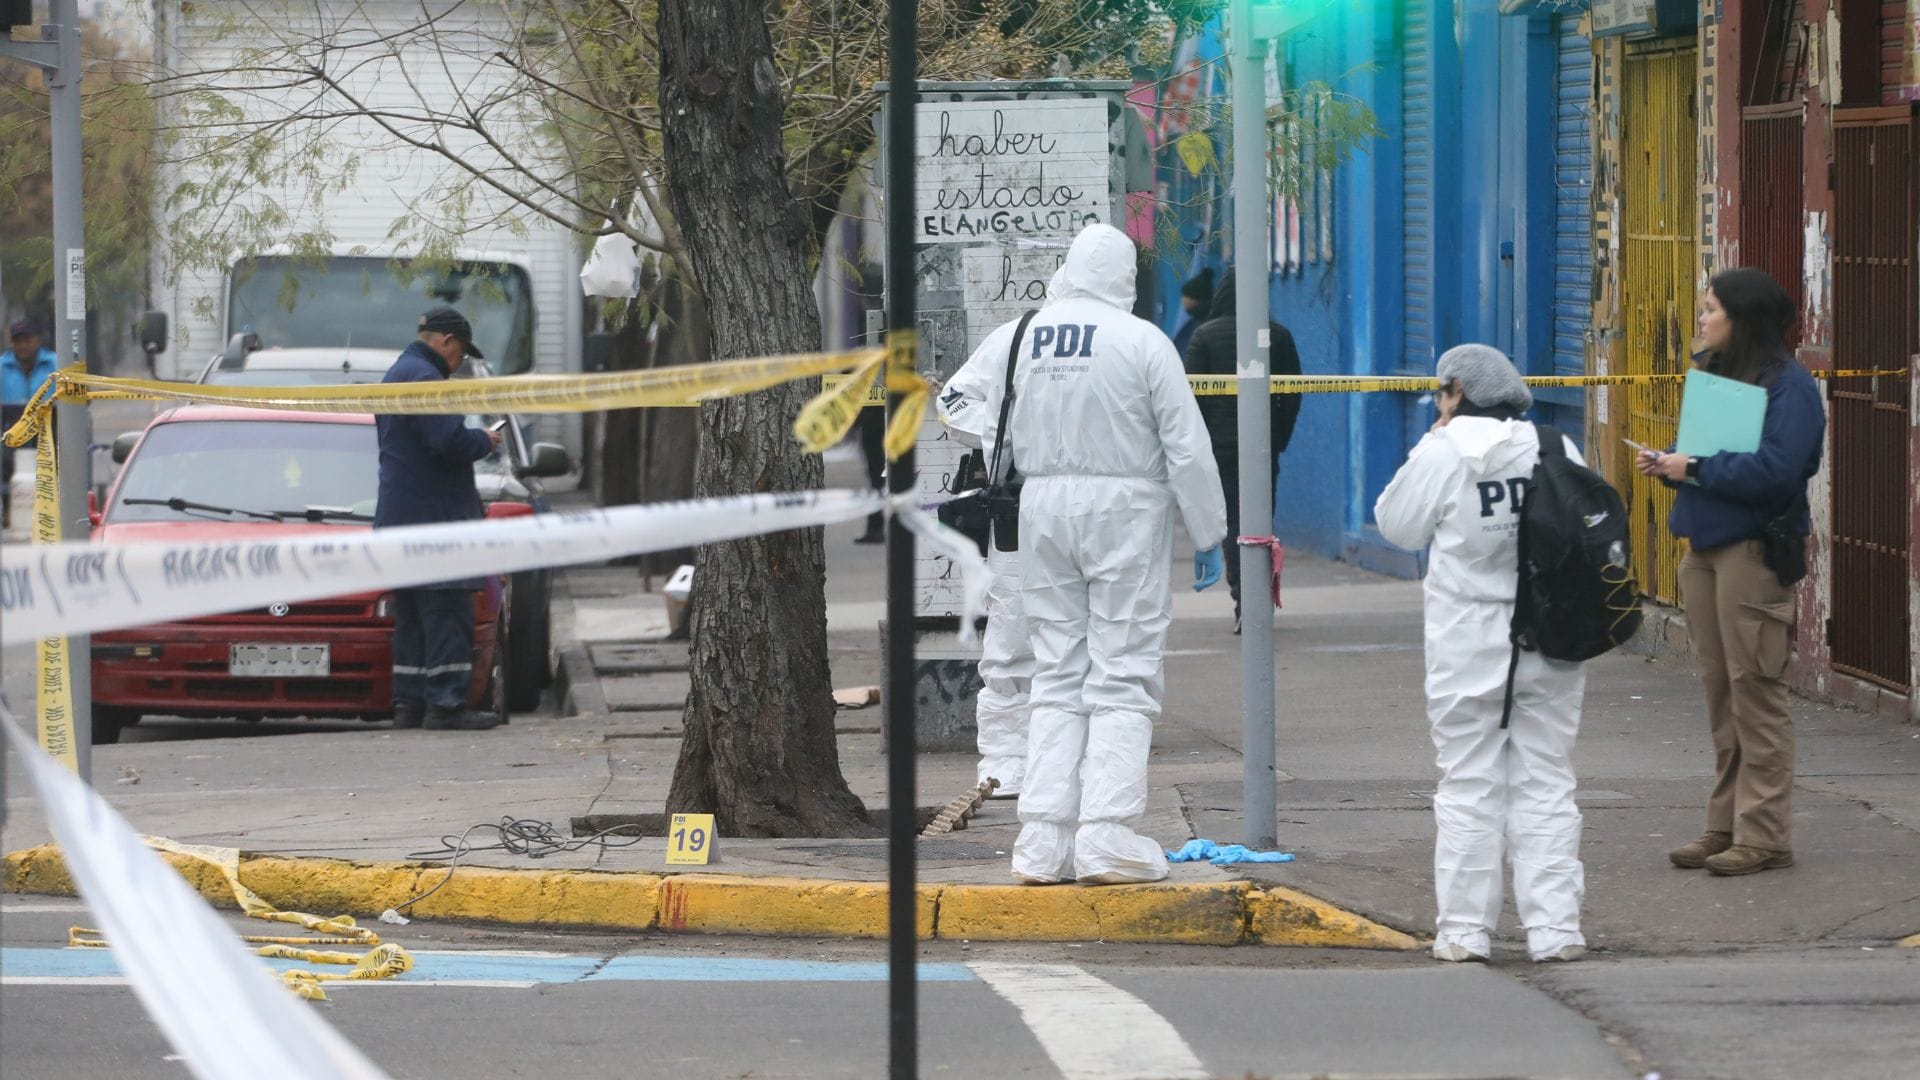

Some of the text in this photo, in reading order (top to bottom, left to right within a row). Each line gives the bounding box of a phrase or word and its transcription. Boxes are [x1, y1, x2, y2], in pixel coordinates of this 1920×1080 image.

[932, 110, 1056, 157] haber
[1032, 324, 1097, 360] PDI
[674, 828, 705, 852] 19
